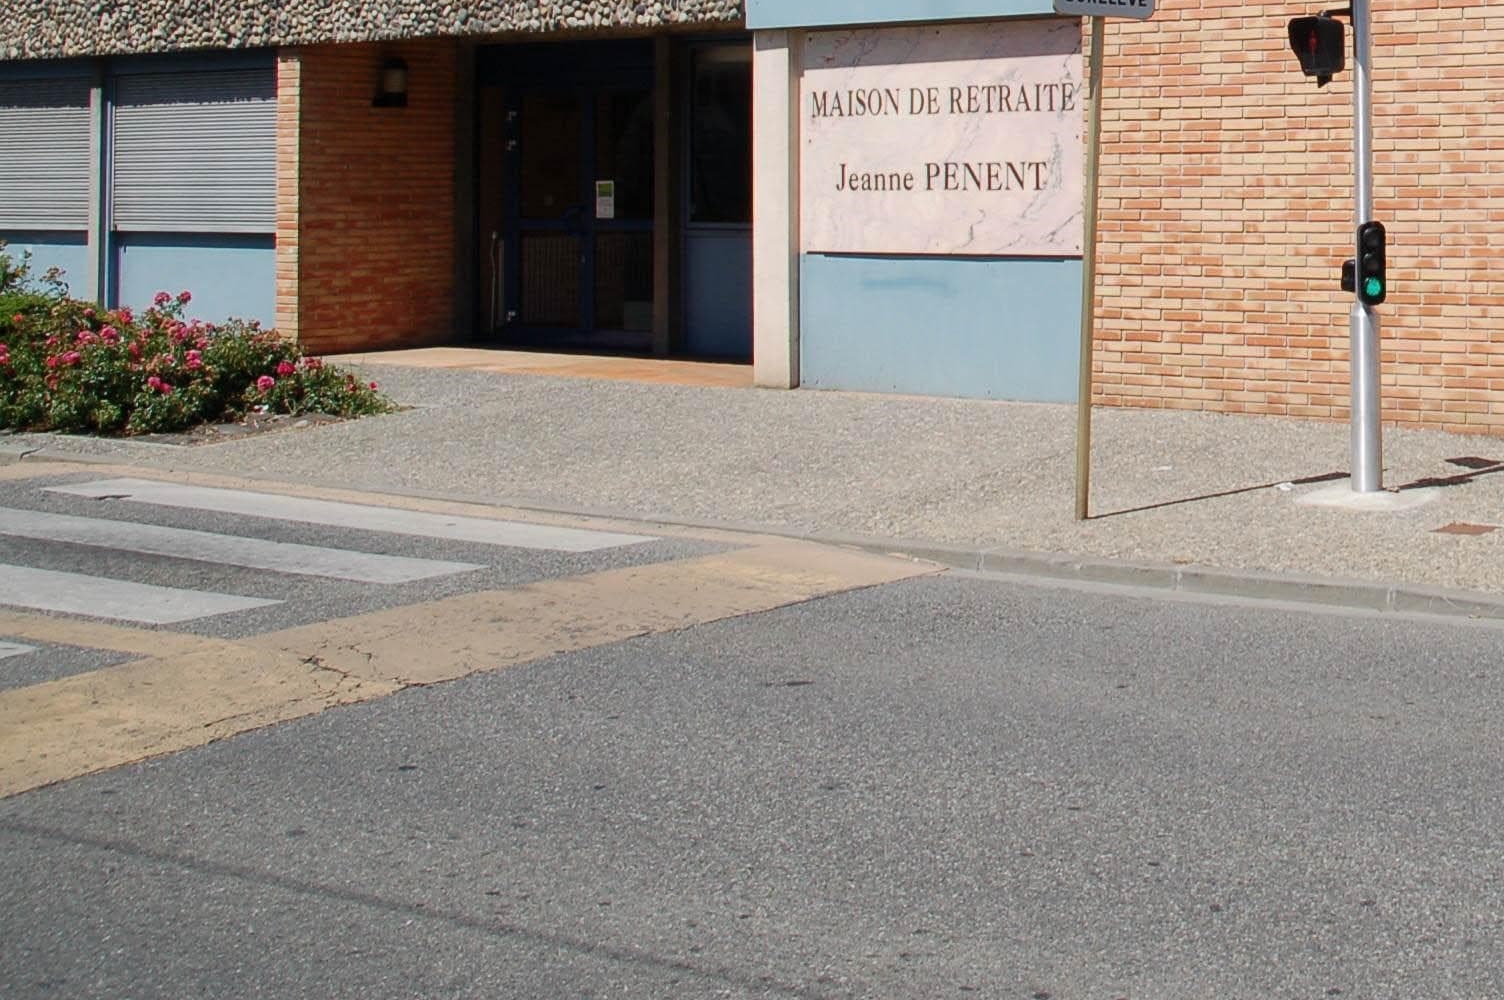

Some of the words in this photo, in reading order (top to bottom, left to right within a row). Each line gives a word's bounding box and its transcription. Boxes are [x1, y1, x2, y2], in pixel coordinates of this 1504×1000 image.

[811, 87, 900, 118] MAISON
[909, 87, 940, 115] DE
[949, 82, 1076, 115] RETRAITE
[836, 163, 914, 191] Jeanne
[925, 161, 1047, 191] PENENT
